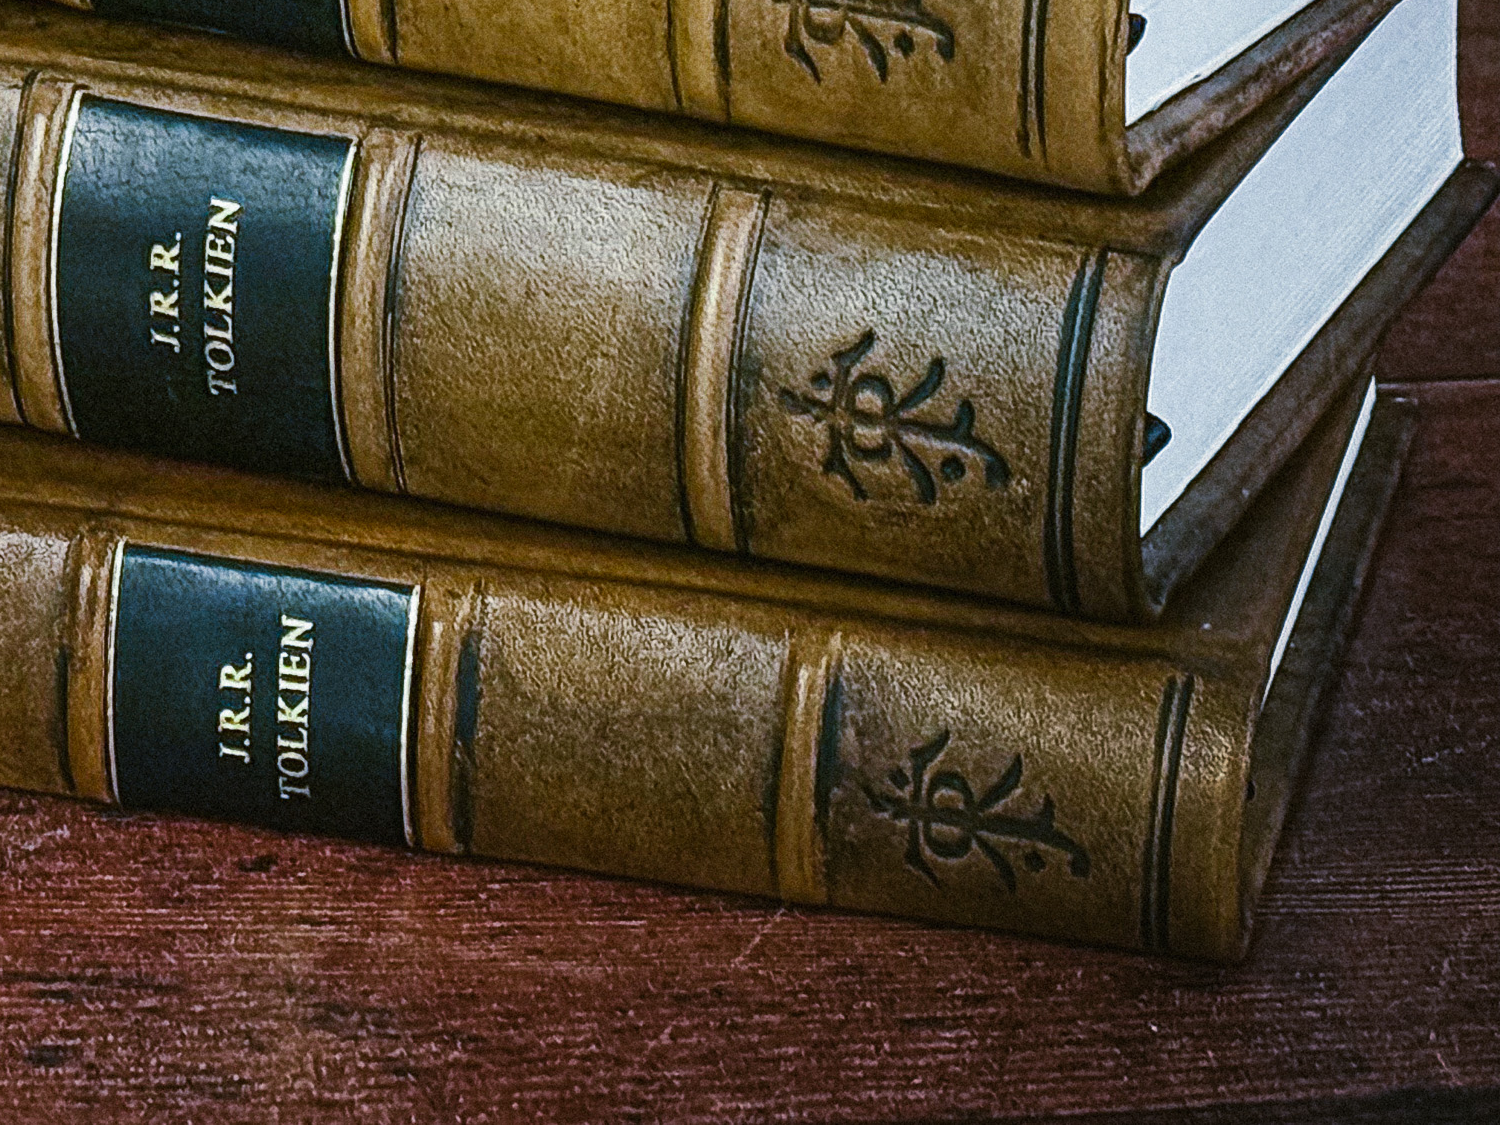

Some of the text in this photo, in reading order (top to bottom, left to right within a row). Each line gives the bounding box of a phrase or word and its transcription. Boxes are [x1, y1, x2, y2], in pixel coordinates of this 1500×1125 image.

[150, 232, 182, 354] J.R.R.
[204, 195, 245, 395] TOLKIEN
[218, 652, 253, 764] J.R.R.
[277, 614, 315, 800] TOLKIEN
